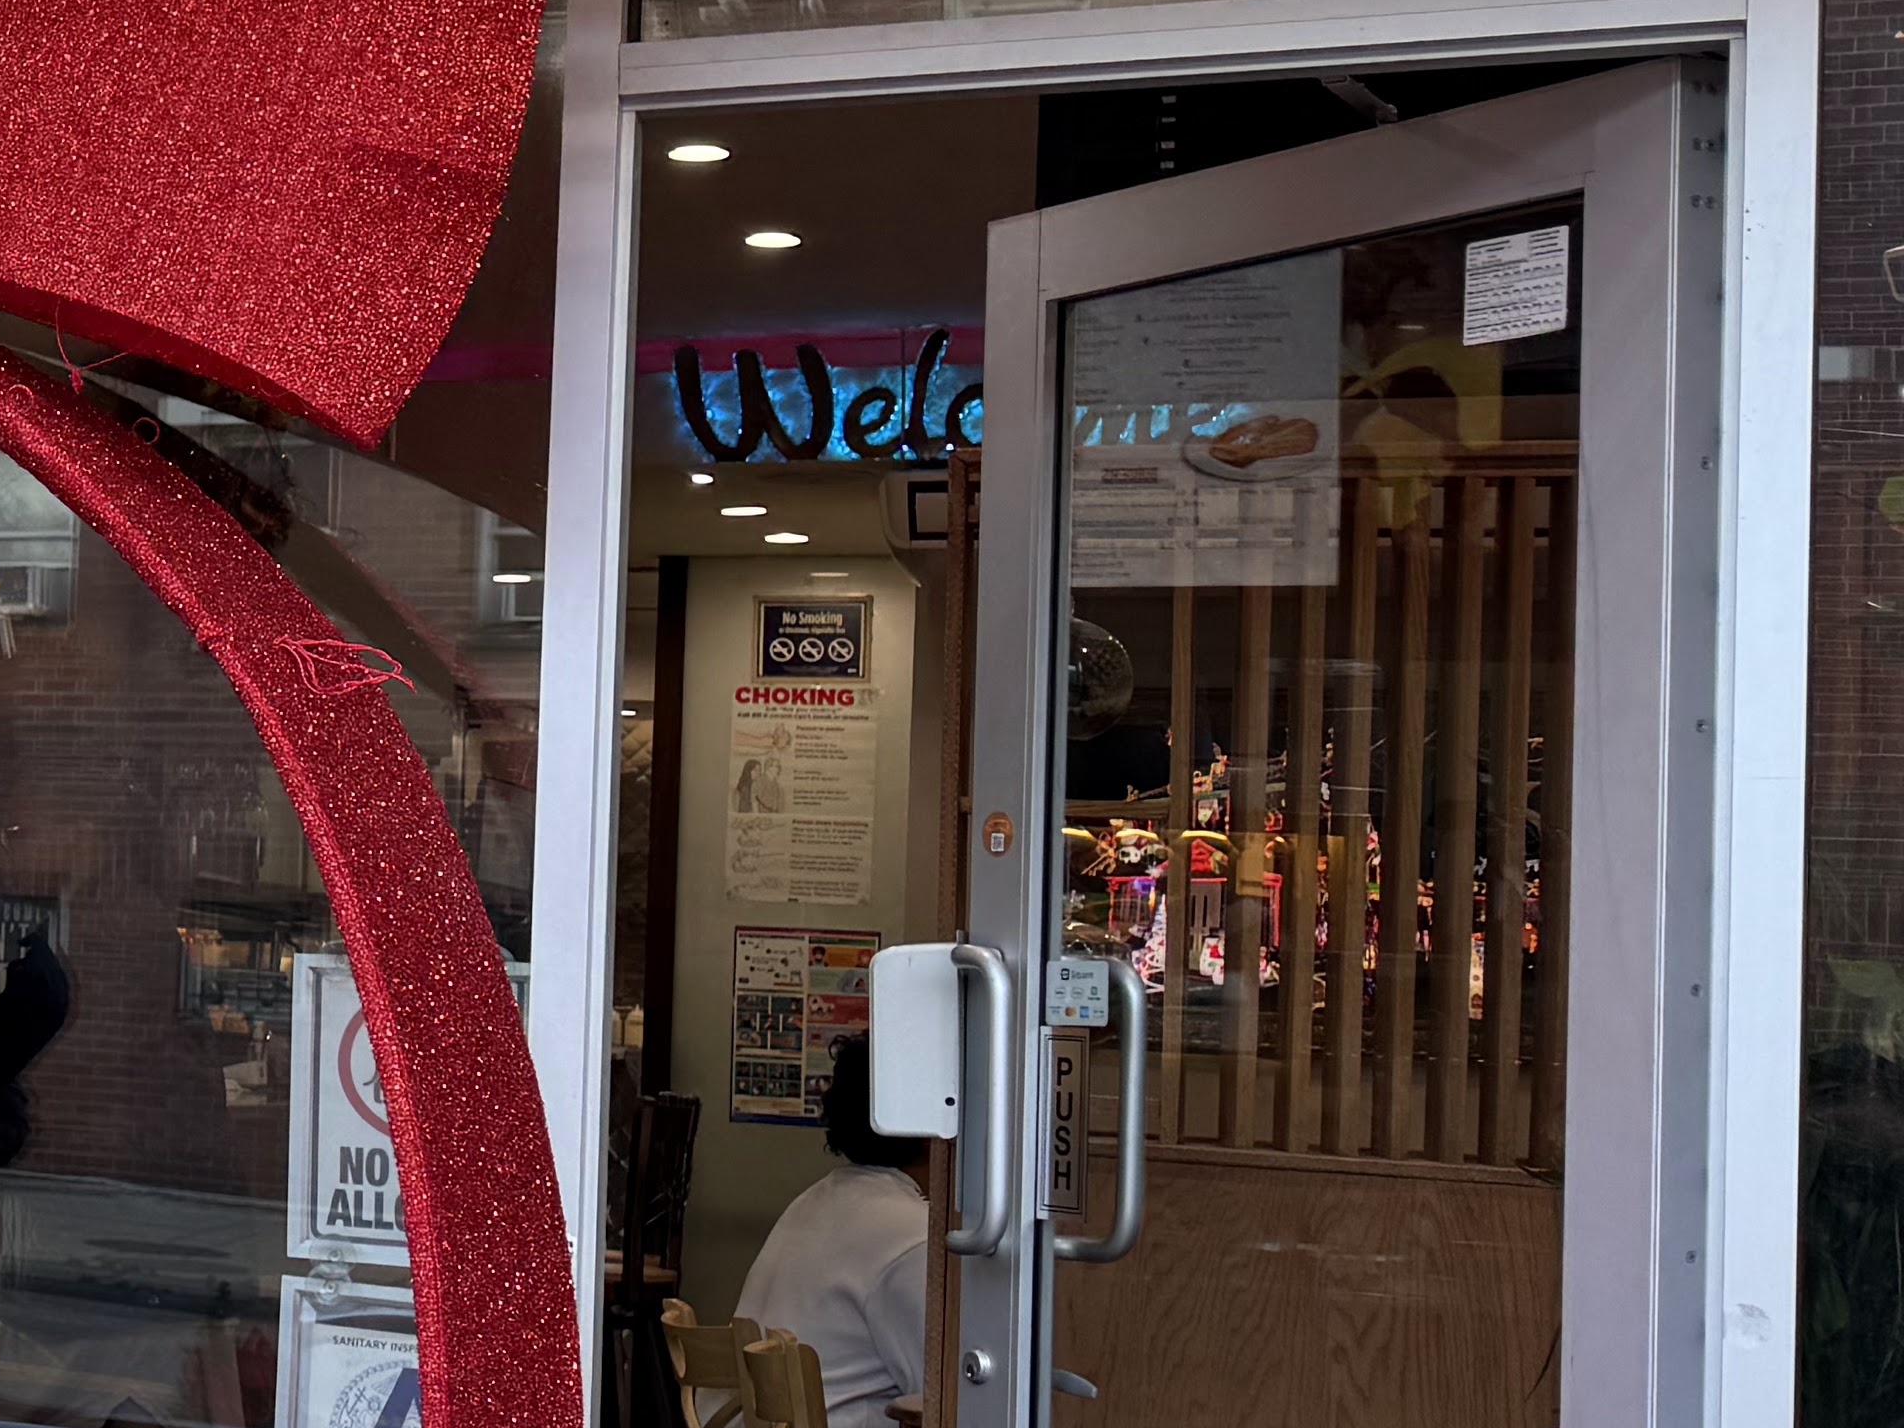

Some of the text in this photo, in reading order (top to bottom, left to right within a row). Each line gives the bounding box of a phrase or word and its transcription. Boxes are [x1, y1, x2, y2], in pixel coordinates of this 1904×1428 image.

[782, 611, 843, 627] No Smoking
[735, 686, 855, 707] CHOKING
[1054, 1056, 1074, 1191] PUSH
[339, 1146, 390, 1188] NO
[332, 1335, 387, 1350] SANITARY
